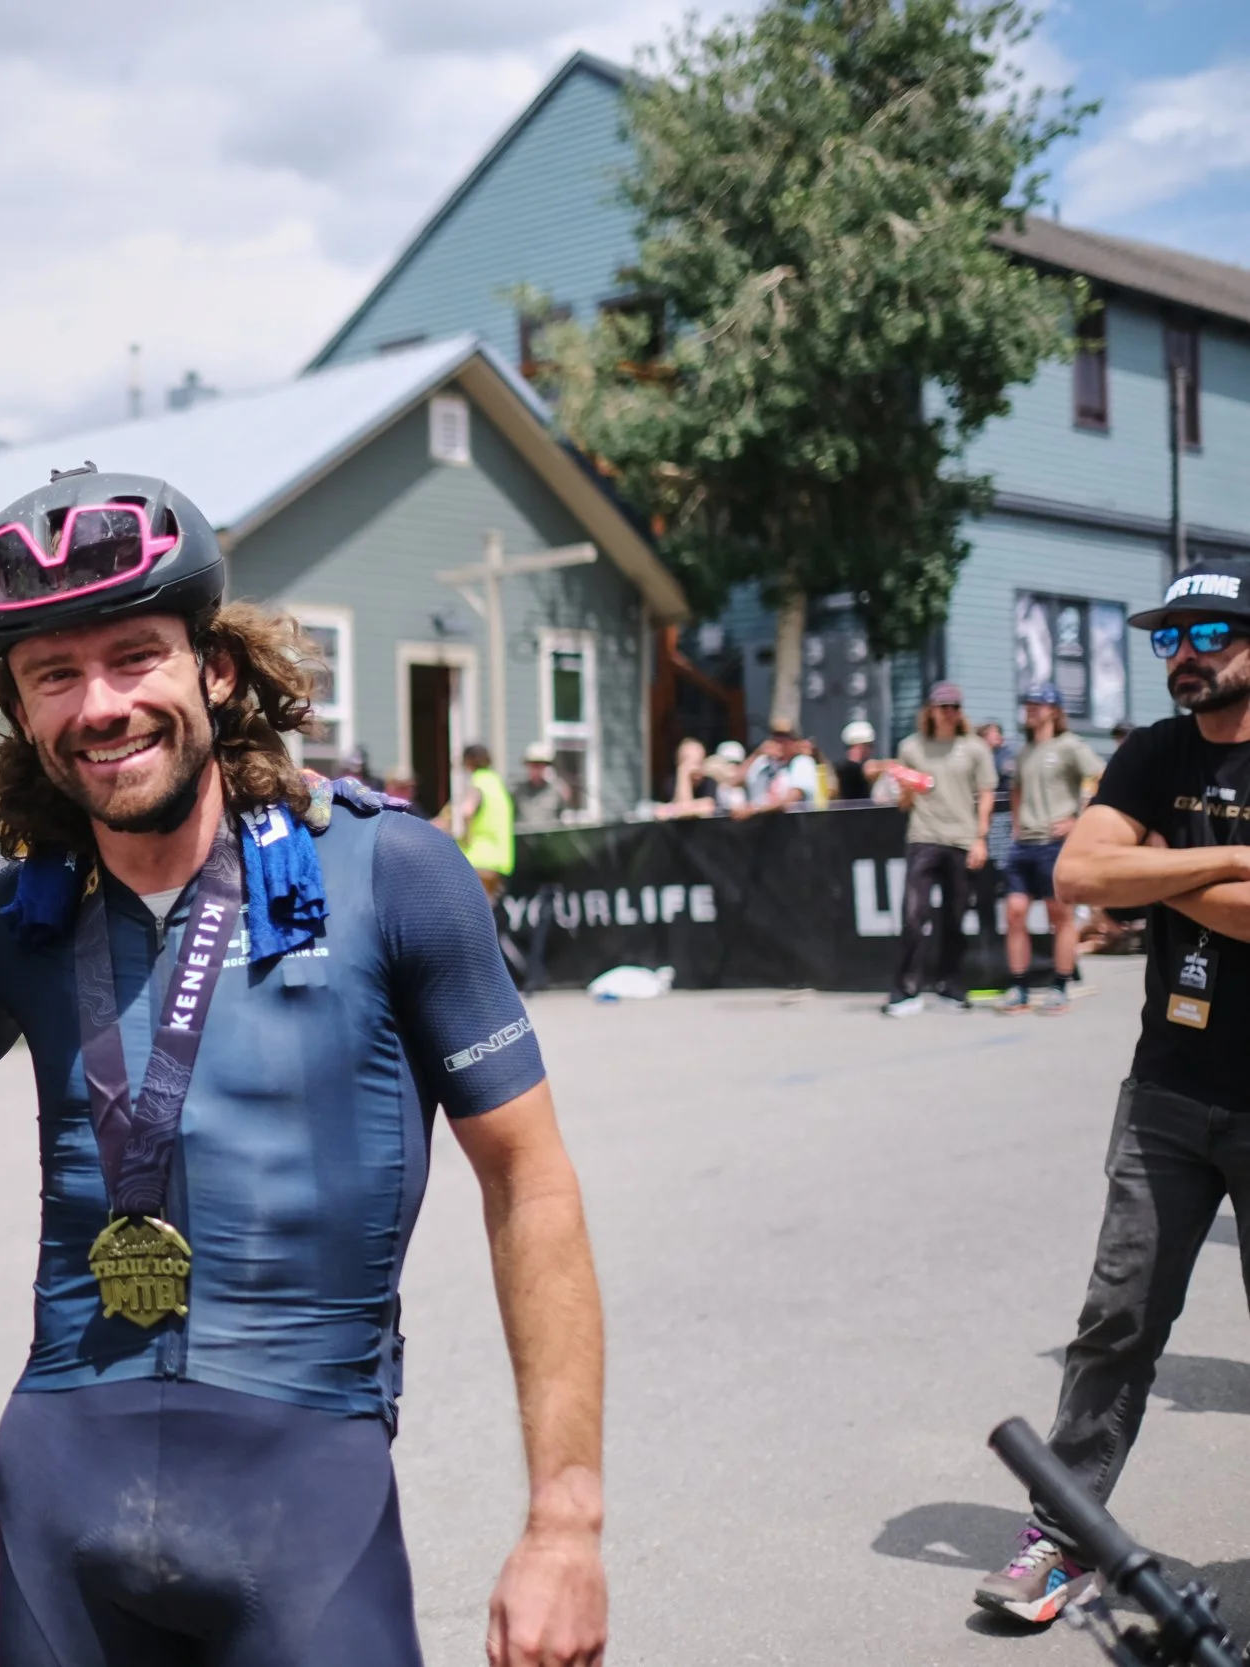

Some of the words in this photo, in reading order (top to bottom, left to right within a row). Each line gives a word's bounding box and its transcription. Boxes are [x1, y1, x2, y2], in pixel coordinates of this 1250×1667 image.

[169, 902, 226, 1030] KENETIK
[91, 1258, 149, 1279] TRAIL
[153, 1257, 190, 1278] 100
[111, 1277, 176, 1312] MTB
